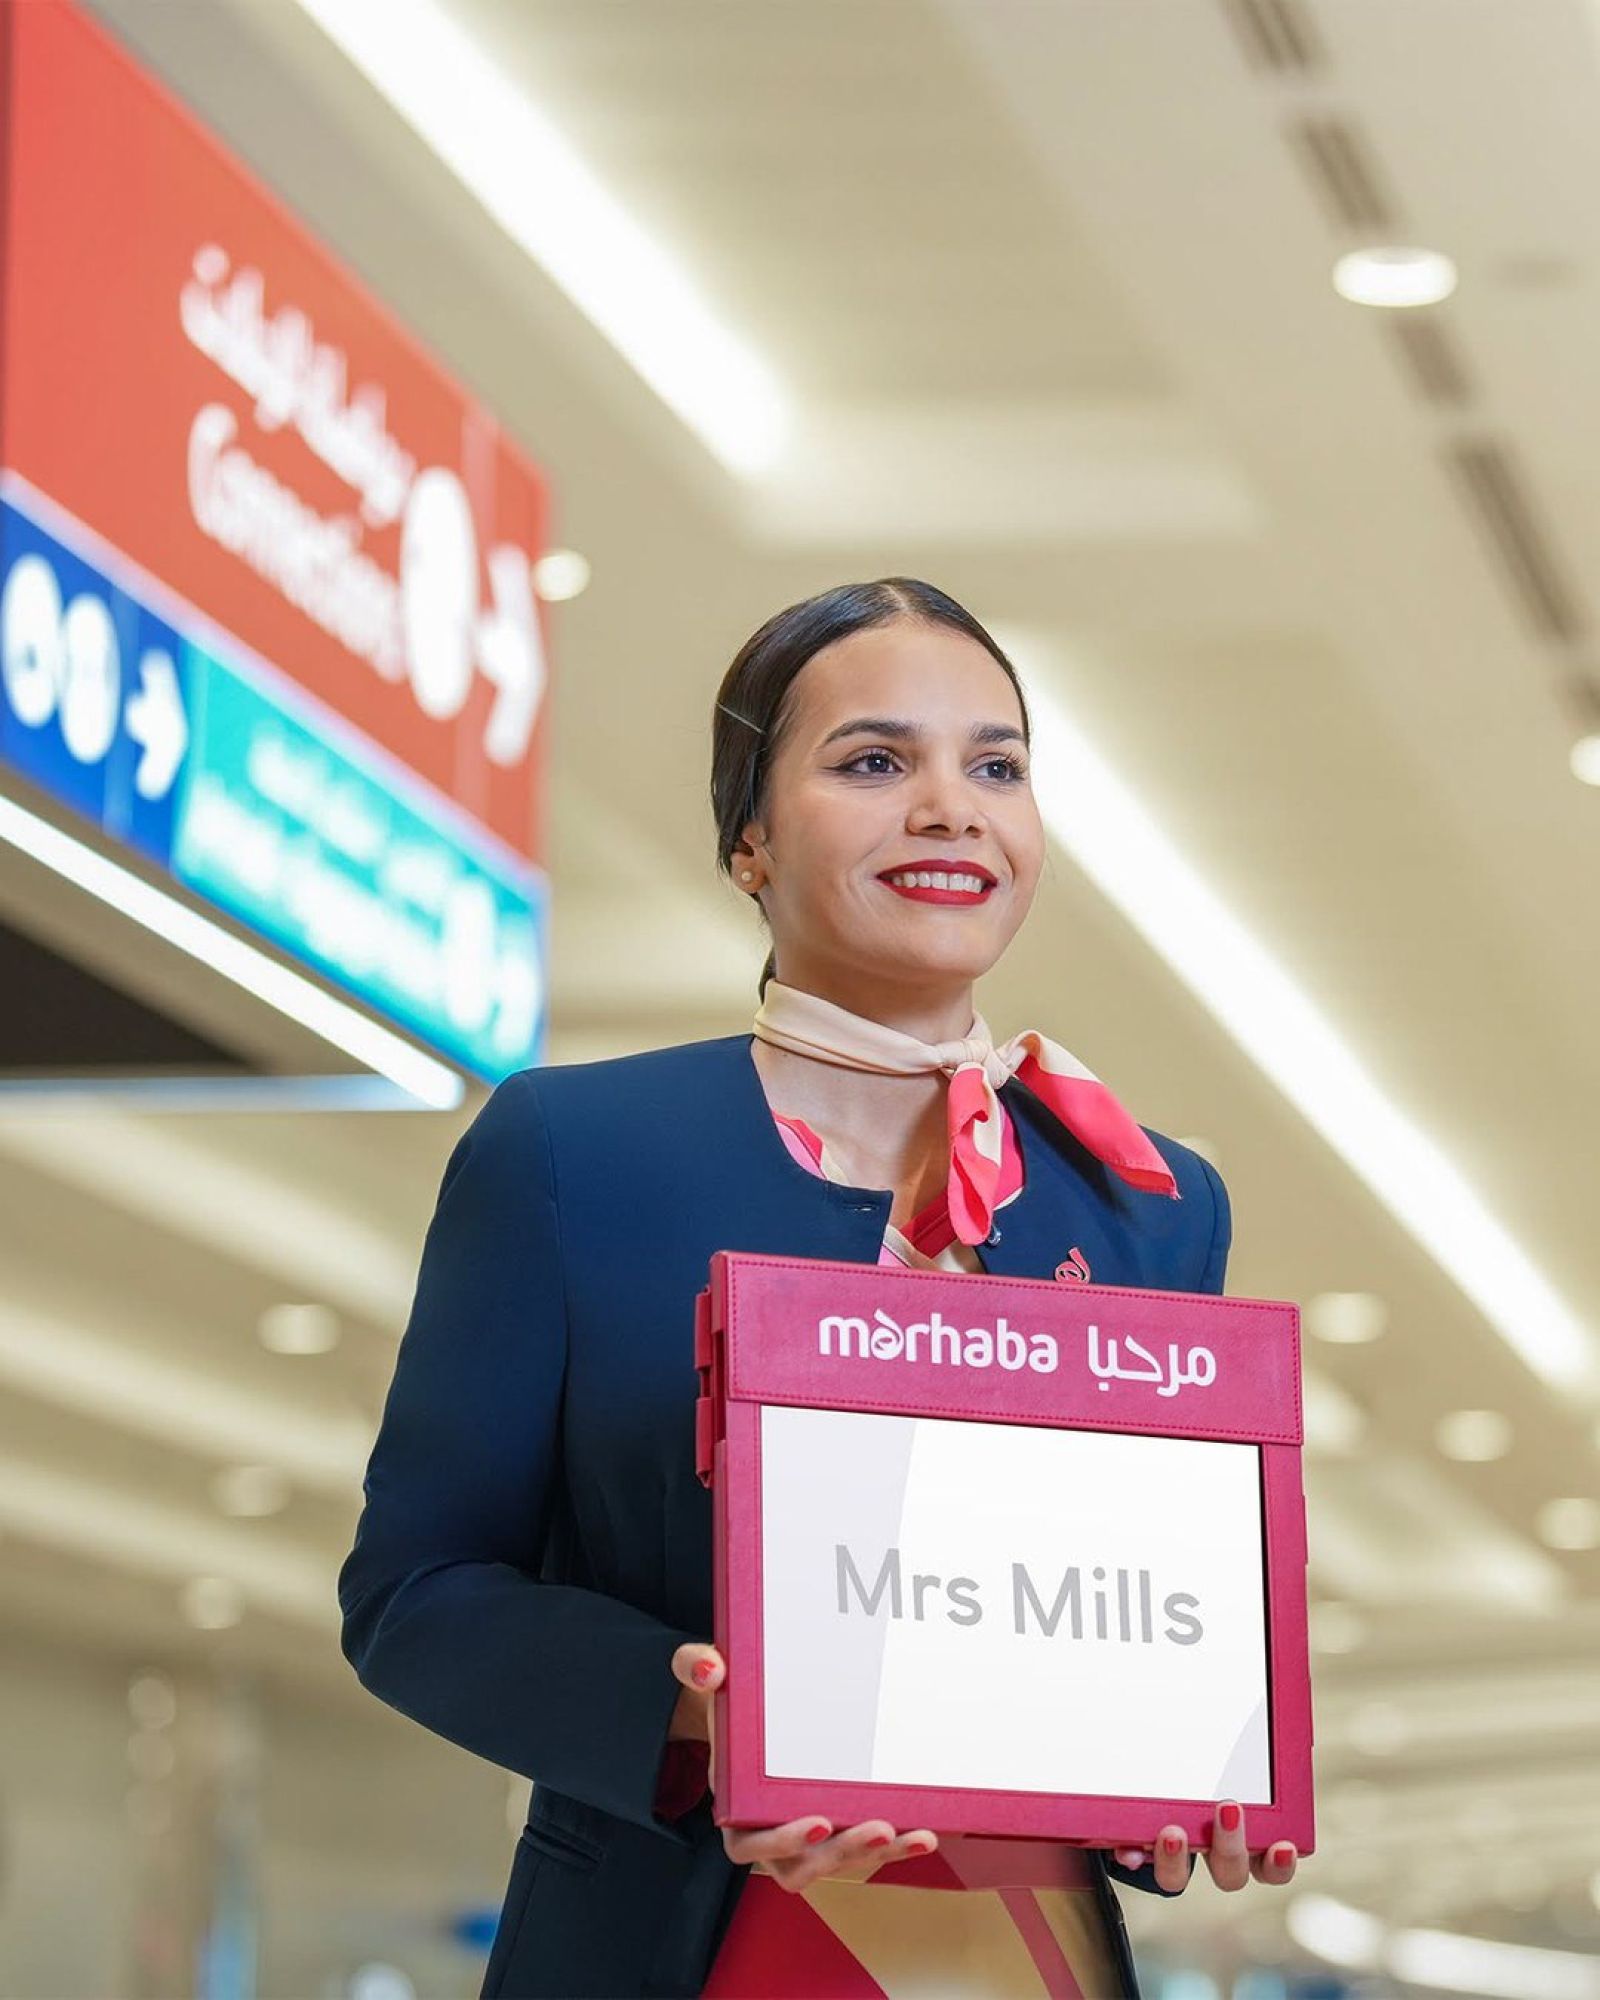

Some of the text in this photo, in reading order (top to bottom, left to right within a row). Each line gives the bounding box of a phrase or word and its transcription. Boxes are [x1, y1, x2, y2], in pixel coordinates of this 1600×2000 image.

[1087, 1325, 1217, 1398] مرحبا
[835, 1544, 1204, 1646] Mrs Mills
